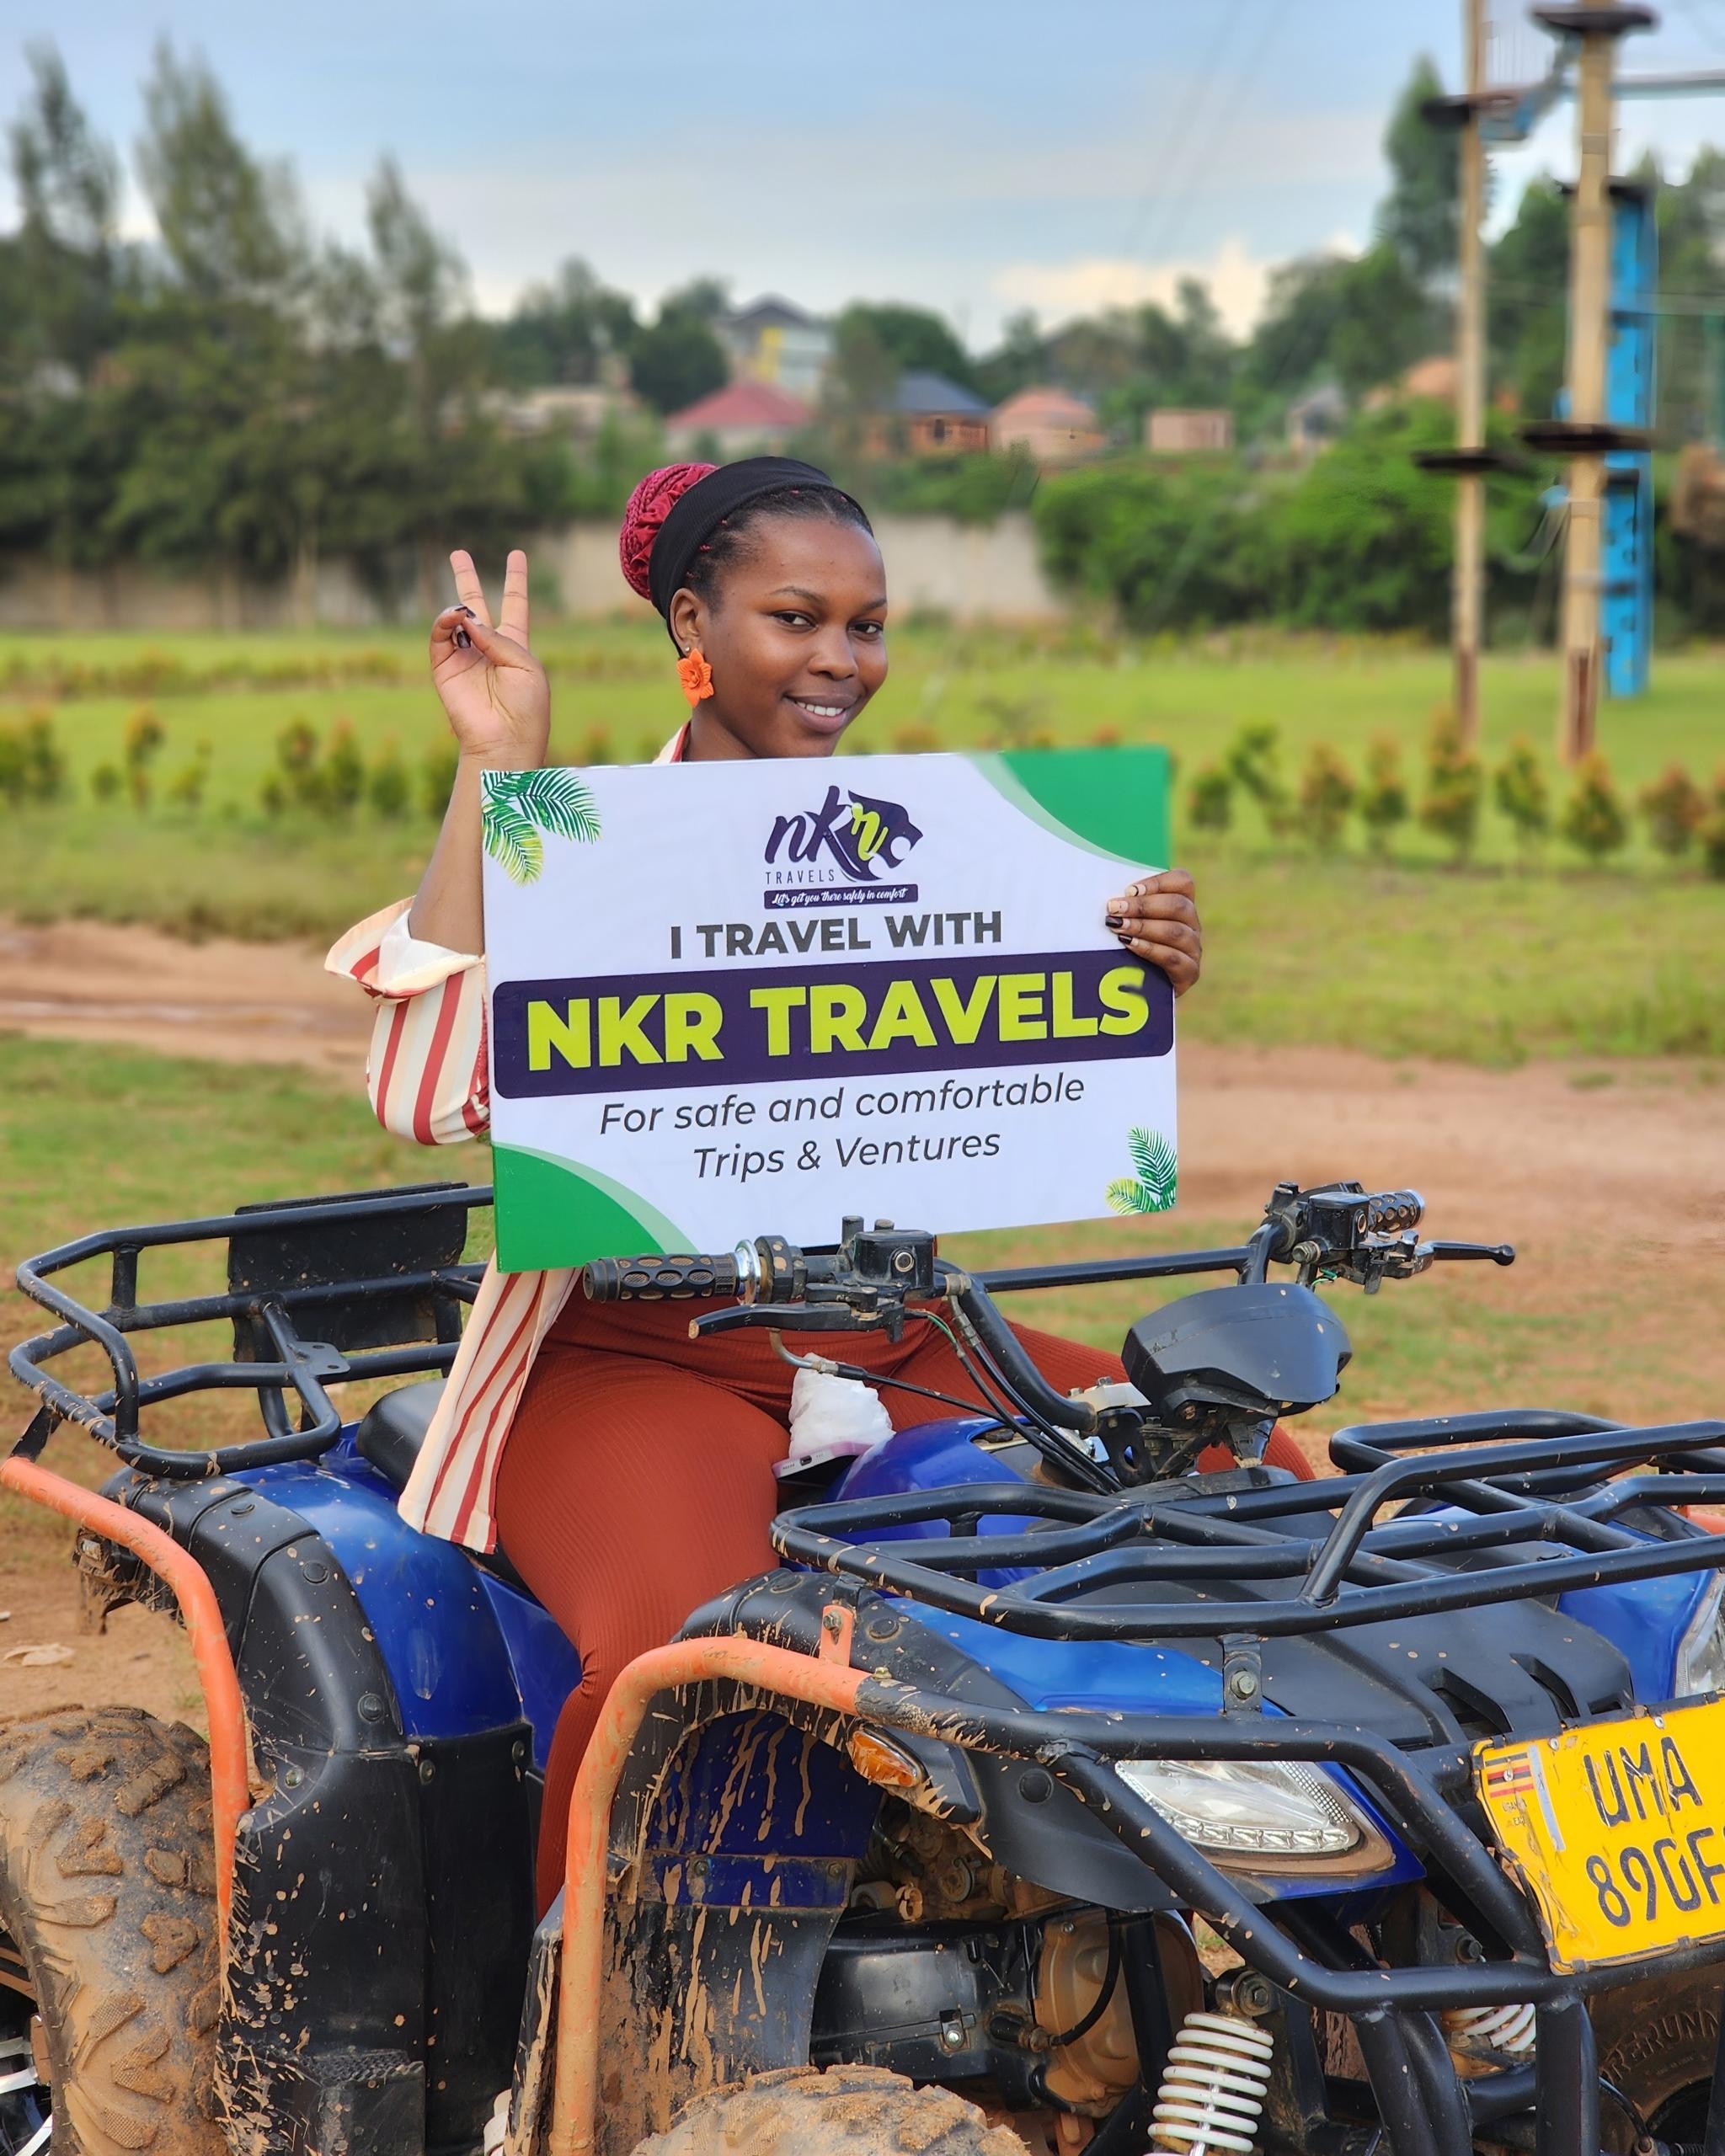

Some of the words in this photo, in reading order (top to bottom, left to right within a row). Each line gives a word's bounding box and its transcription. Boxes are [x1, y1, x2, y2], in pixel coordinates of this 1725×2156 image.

[766, 869, 835, 884] TRAVELS
[791, 892, 806, 906] get
[804, 894, 820, 906] you
[821, 891, 841, 901] there
[843, 889, 865, 903] safely
[866, 889, 876, 899] in
[876, 888, 908, 902] comfort
[670, 926, 681, 959] I
[696, 917, 871, 958] TRAVEL
[884, 910, 1001, 947] WITH
[527, 992, 724, 1071] NKR
[750, 966, 1149, 1056] TRAVELS
[600, 1103, 664, 1134] For
[674, 1094, 756, 1129] safe
[768, 1086, 844, 1123] and
[856, 1072, 1084, 1116] comfortable
[694, 1143, 784, 1182] Trips
[797, 1140, 820, 1170] &
[836, 1132, 1001, 1167] Ventures
[1583, 1737, 1702, 1828] UMA
[1586, 1826, 1725, 1927] 890F
